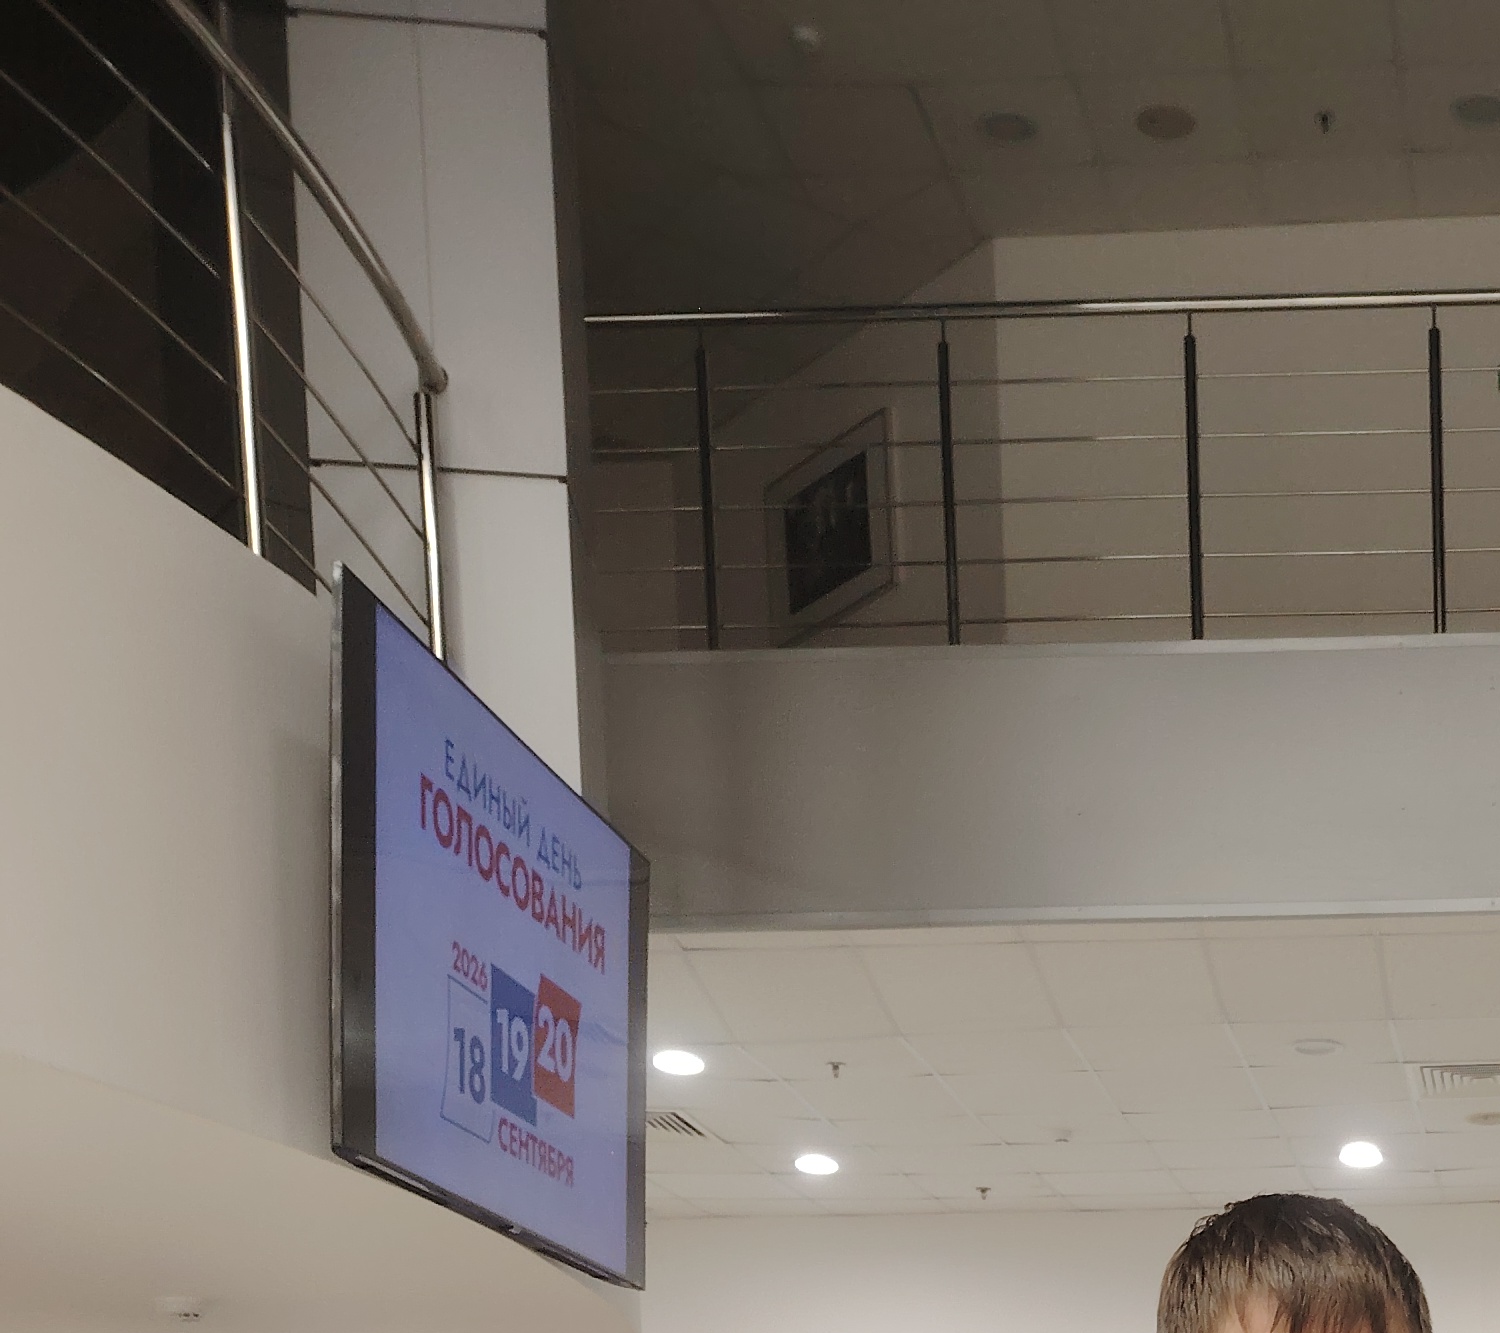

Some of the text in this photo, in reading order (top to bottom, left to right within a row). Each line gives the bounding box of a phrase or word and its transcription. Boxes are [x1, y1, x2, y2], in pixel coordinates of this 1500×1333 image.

[445, 739, 582, 890] ЕДИНЫЙ ДЕНЬ
[420, 772, 605, 975] ГОЛОСОВАНИЯ
[452, 940, 488, 991] 2026
[454, 1005, 573, 1104] 18 19 20
[498, 1116, 575, 1187] СЕНТЯБРЯ
